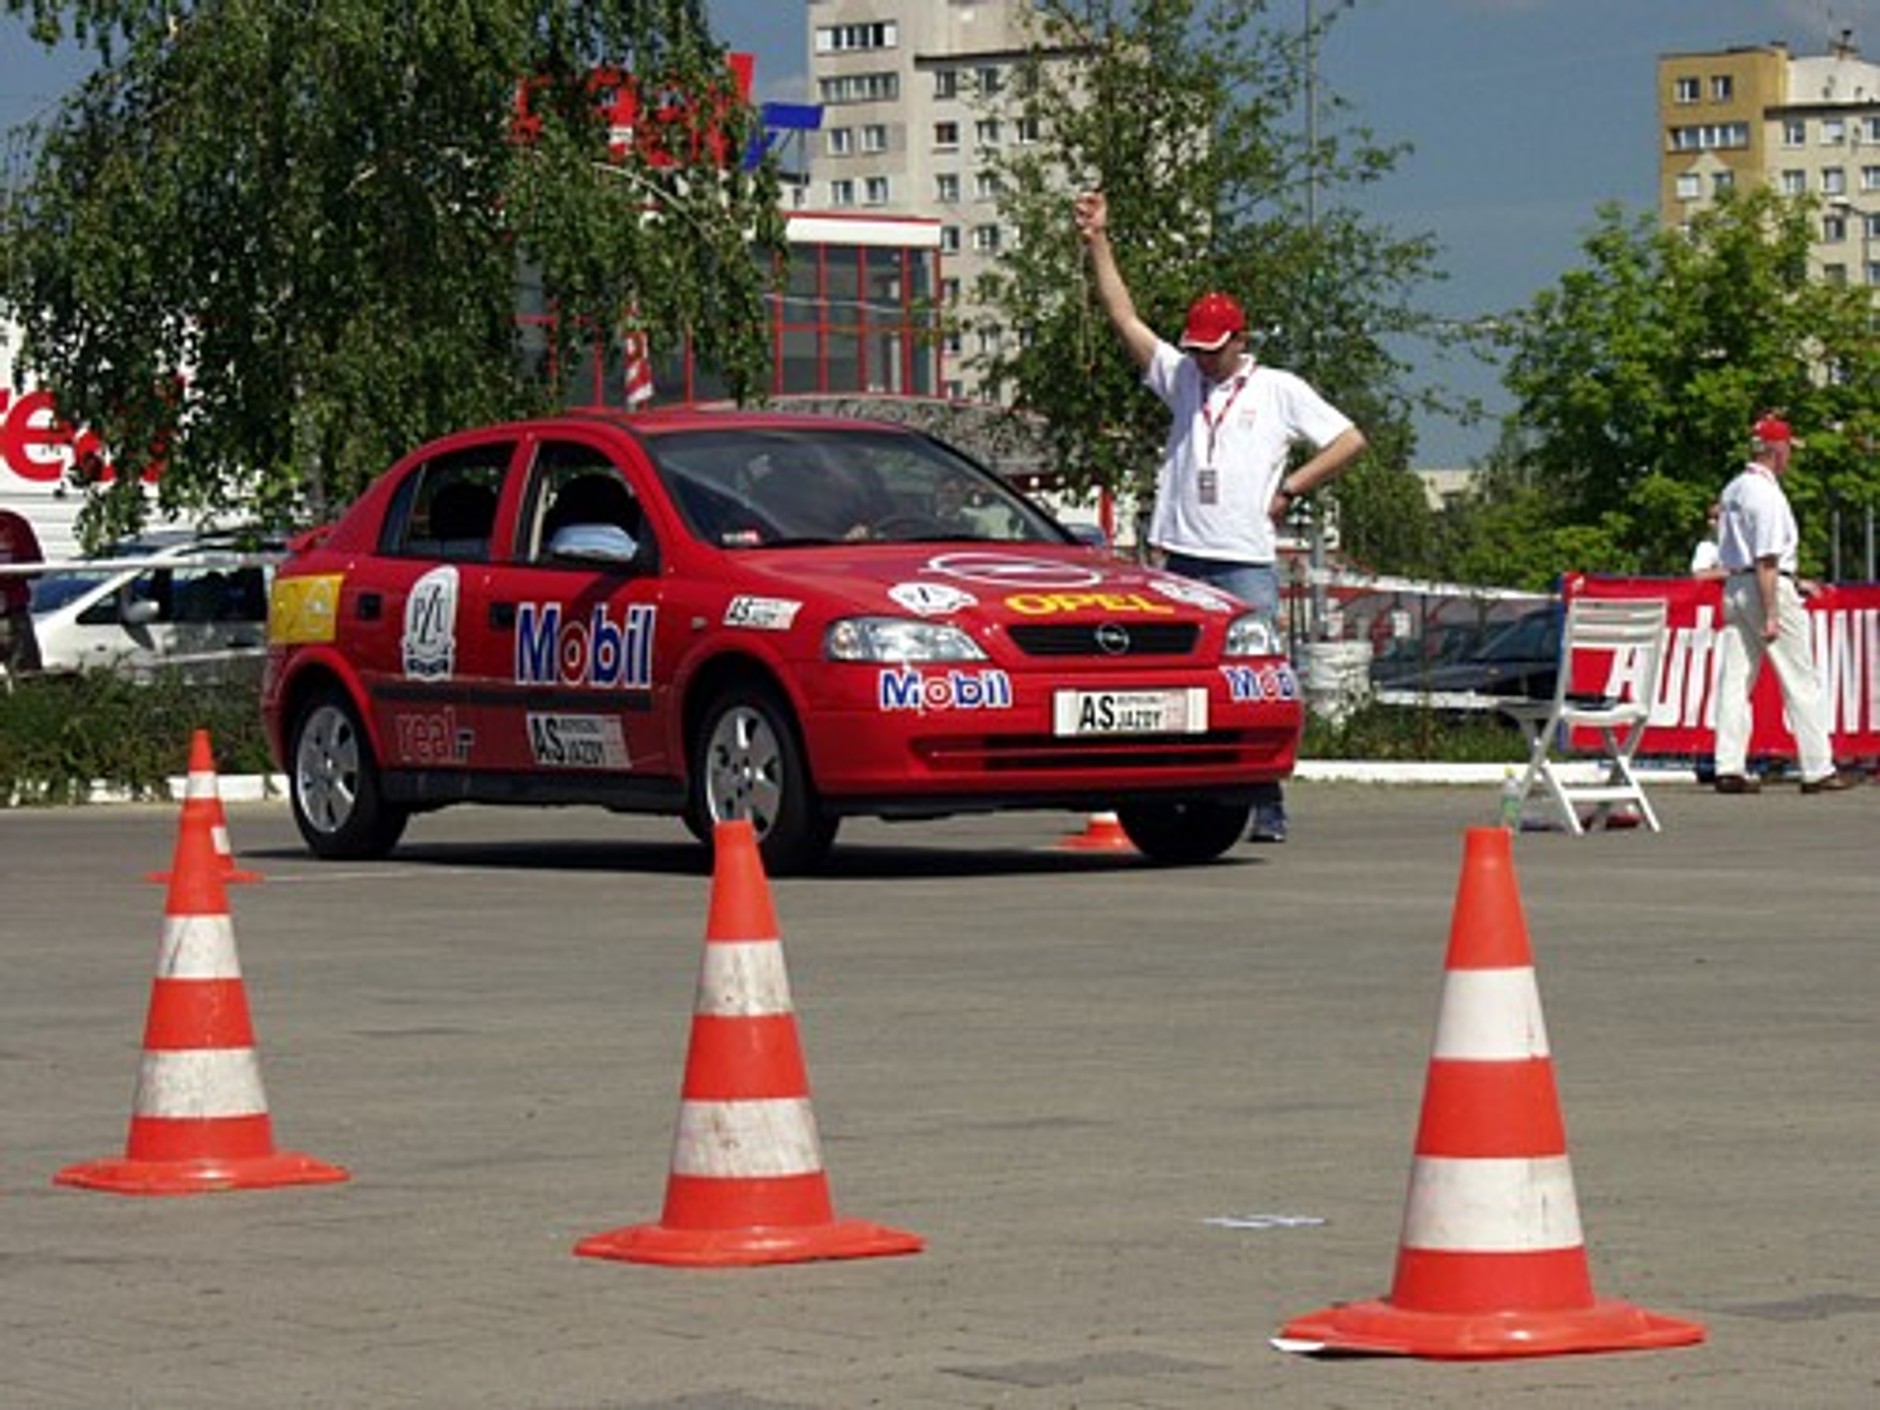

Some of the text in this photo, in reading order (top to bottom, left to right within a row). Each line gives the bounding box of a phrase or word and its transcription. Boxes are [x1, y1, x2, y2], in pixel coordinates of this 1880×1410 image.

[1005, 593, 1175, 616] OPEL
[515, 602, 657, 690] Mobil
[879, 668, 1013, 713] Mobil
[1078, 694, 1115, 730] AS
[531, 717, 566, 762] AS
